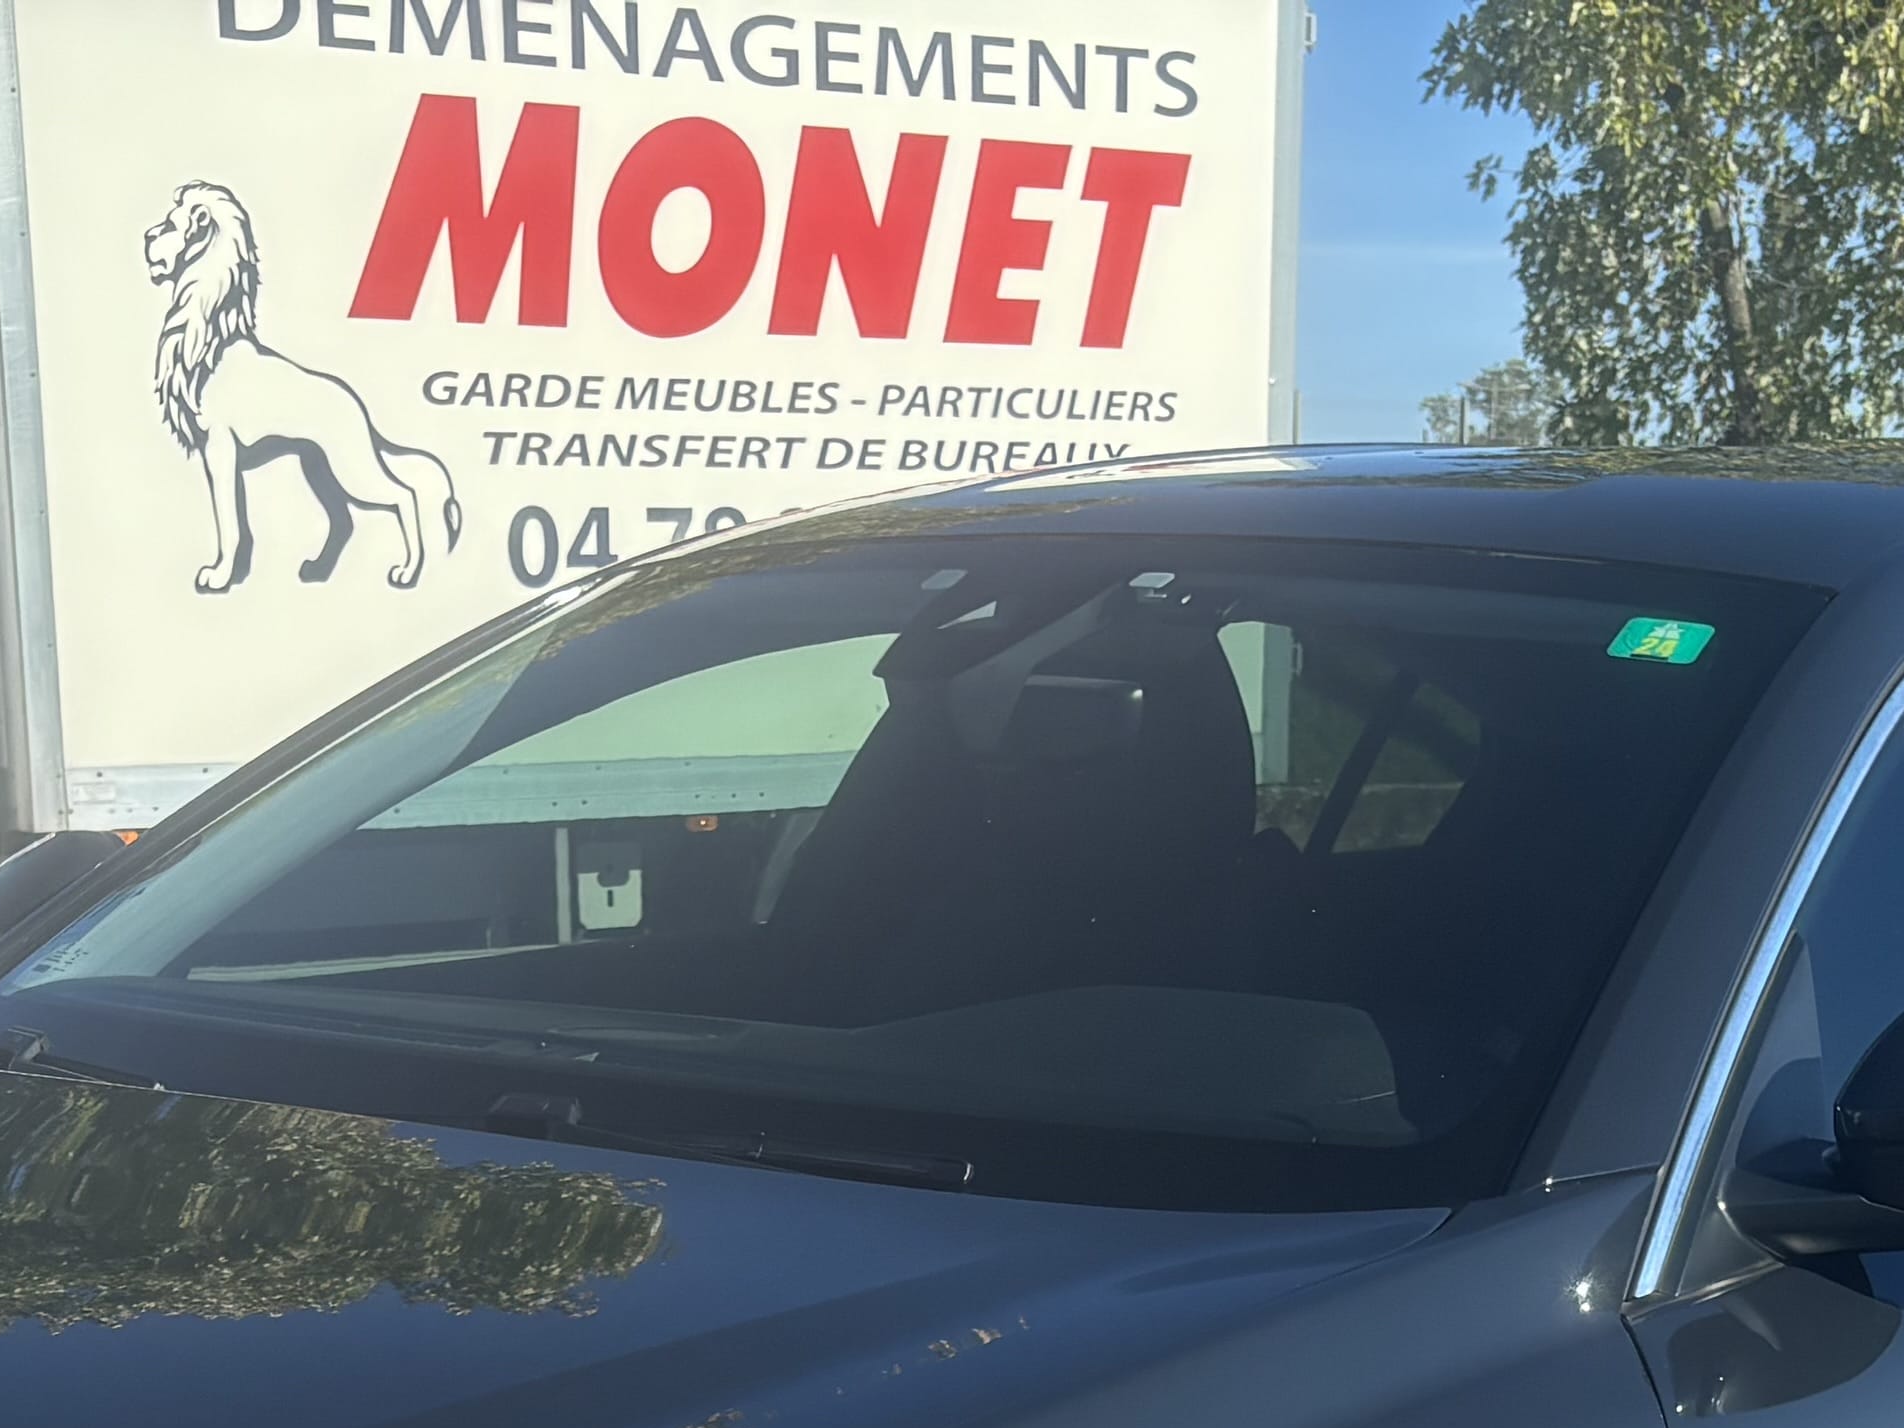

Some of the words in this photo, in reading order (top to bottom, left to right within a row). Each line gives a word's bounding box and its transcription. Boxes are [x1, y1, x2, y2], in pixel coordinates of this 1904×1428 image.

[348, 94, 1191, 349] MONET
[422, 371, 605, 408] GARDE
[614, 377, 840, 414] MEUBLES
[877, 384, 1178, 423] PARTICULIERS
[483, 431, 806, 470] TRANSFERT
[816, 437, 886, 471] DE
[508, 504, 619, 589] 04
